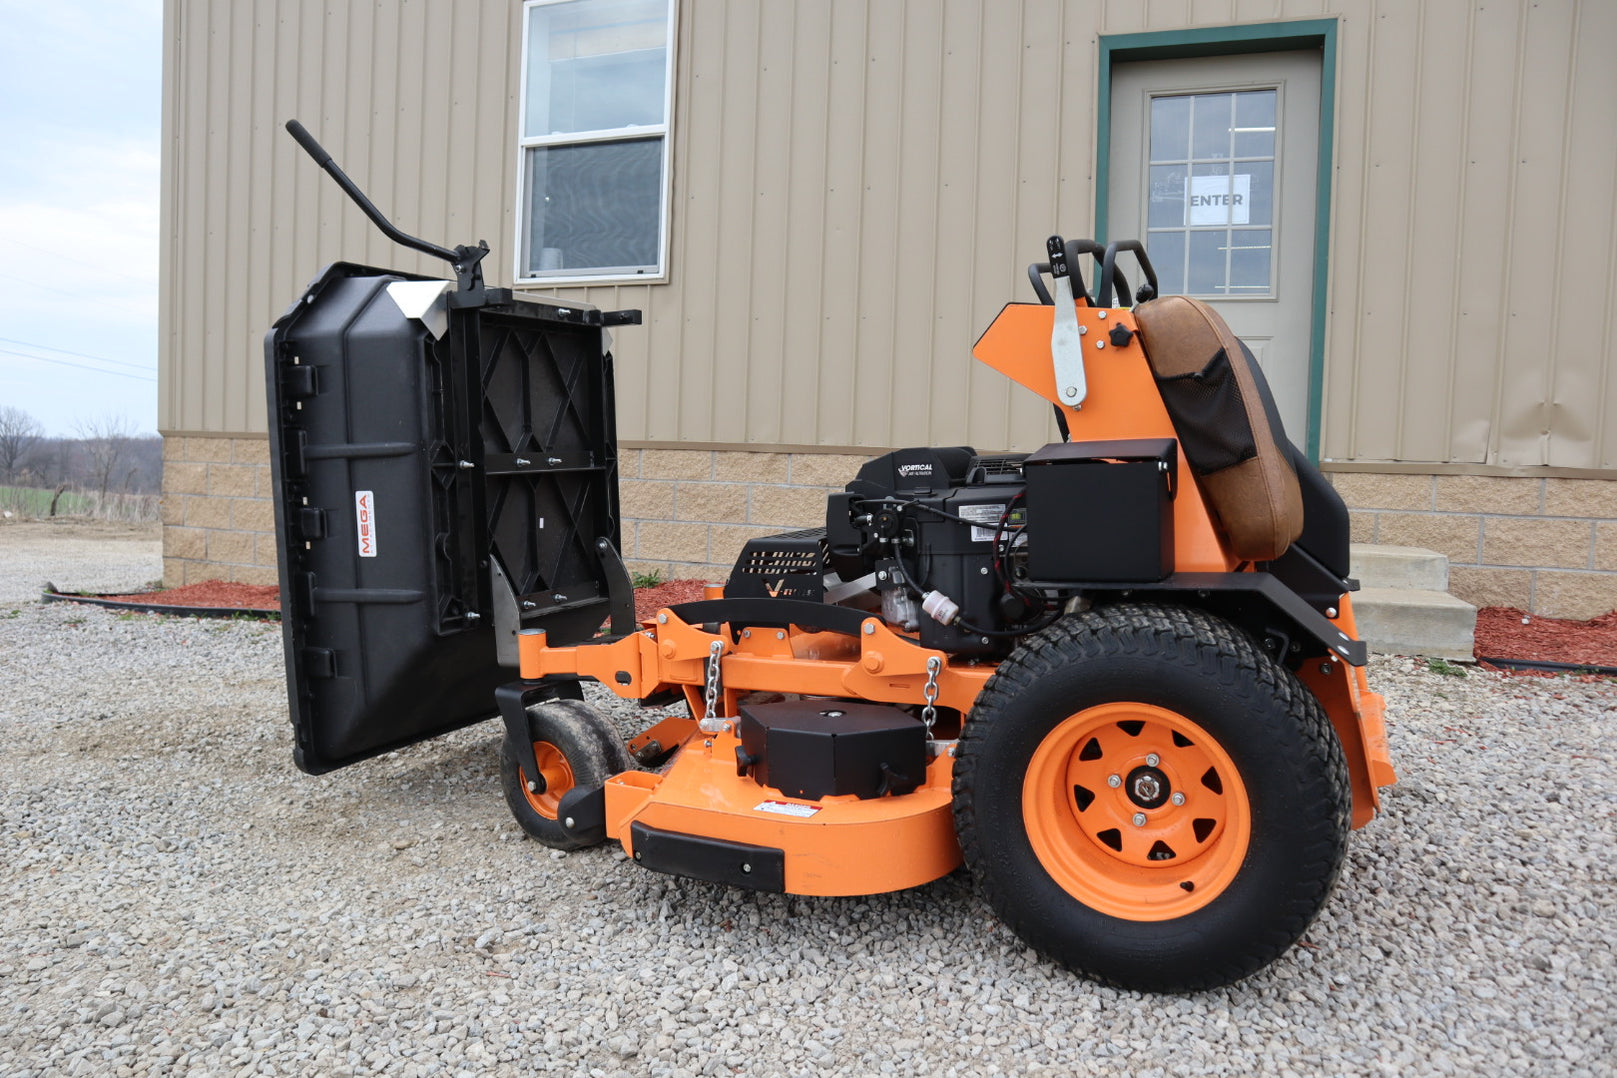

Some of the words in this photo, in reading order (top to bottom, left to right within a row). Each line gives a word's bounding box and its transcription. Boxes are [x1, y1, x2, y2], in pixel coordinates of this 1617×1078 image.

[1190, 194, 1243, 207] ENTER
[900, 463, 933, 471] VORTICAL
[359, 495, 370, 553] MEGA
